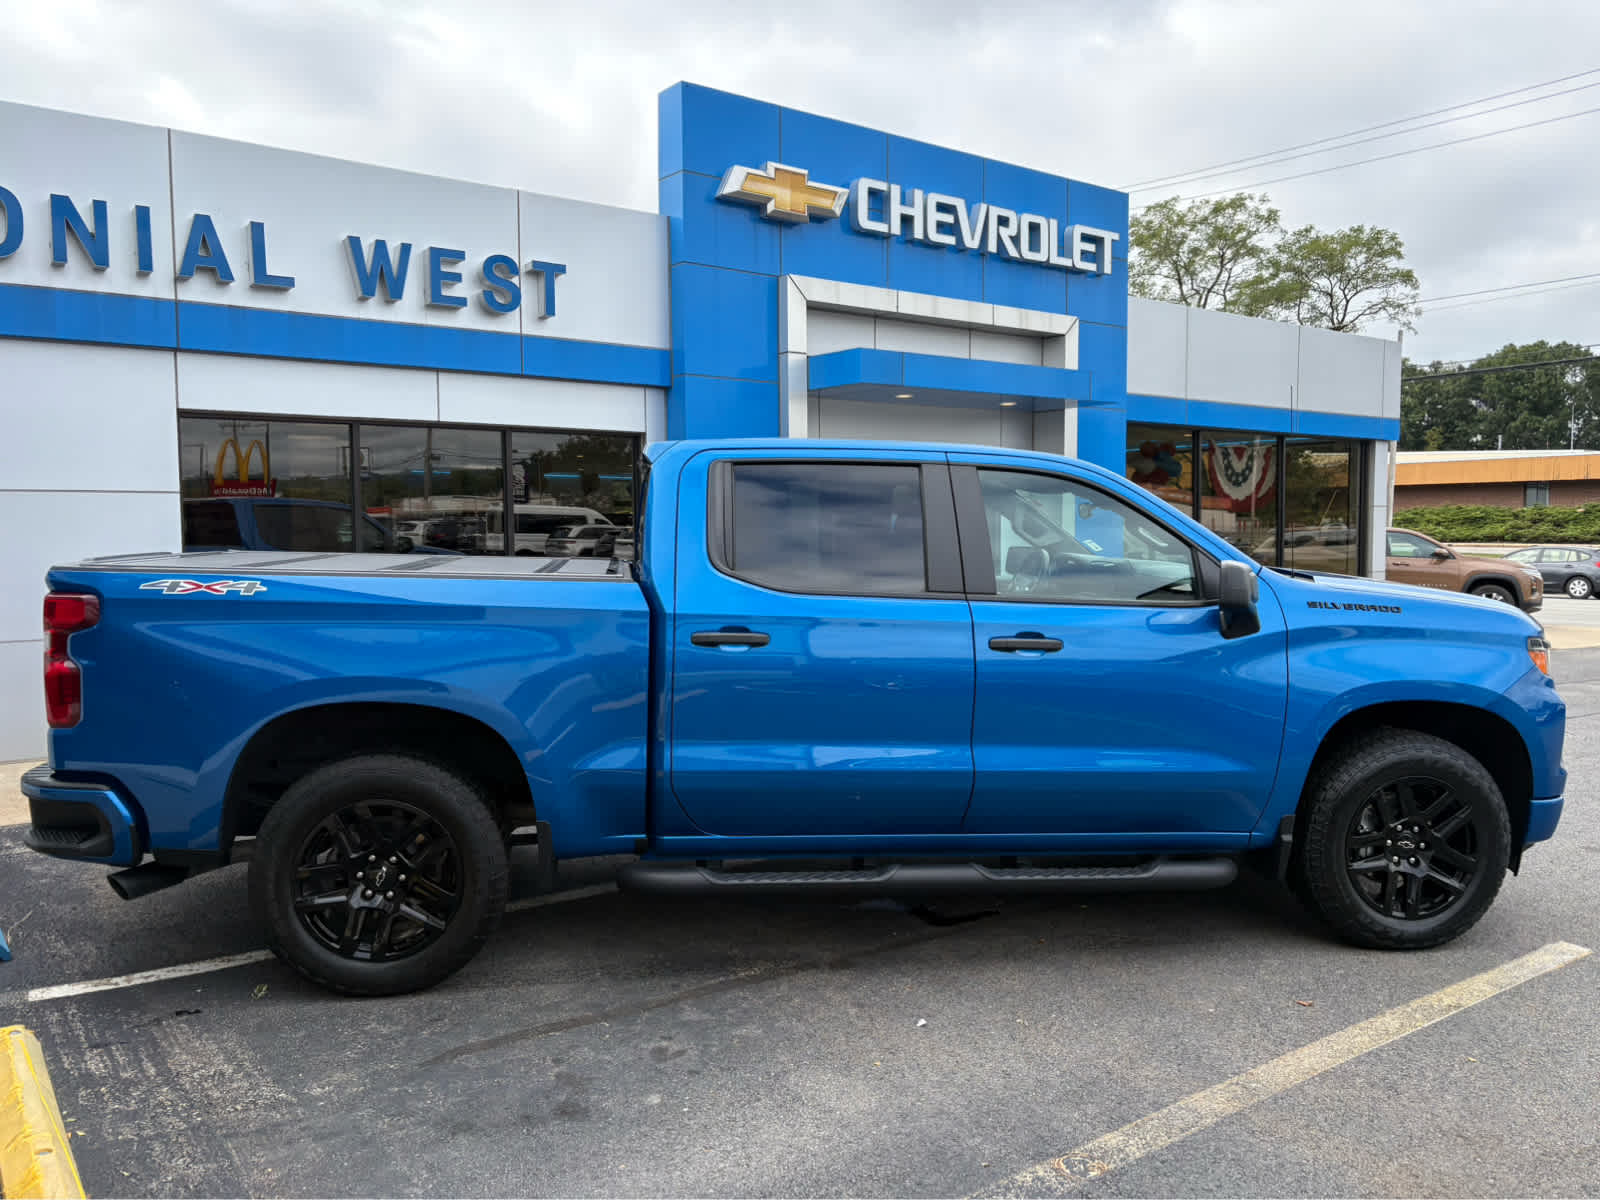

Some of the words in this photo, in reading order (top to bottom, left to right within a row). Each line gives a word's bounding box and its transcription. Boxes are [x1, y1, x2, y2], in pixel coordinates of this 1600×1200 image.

[850, 177, 1121, 275] CHEVROLET
[343, 235, 567, 319] WEST
[1306, 601, 1402, 614] SILVERADO
